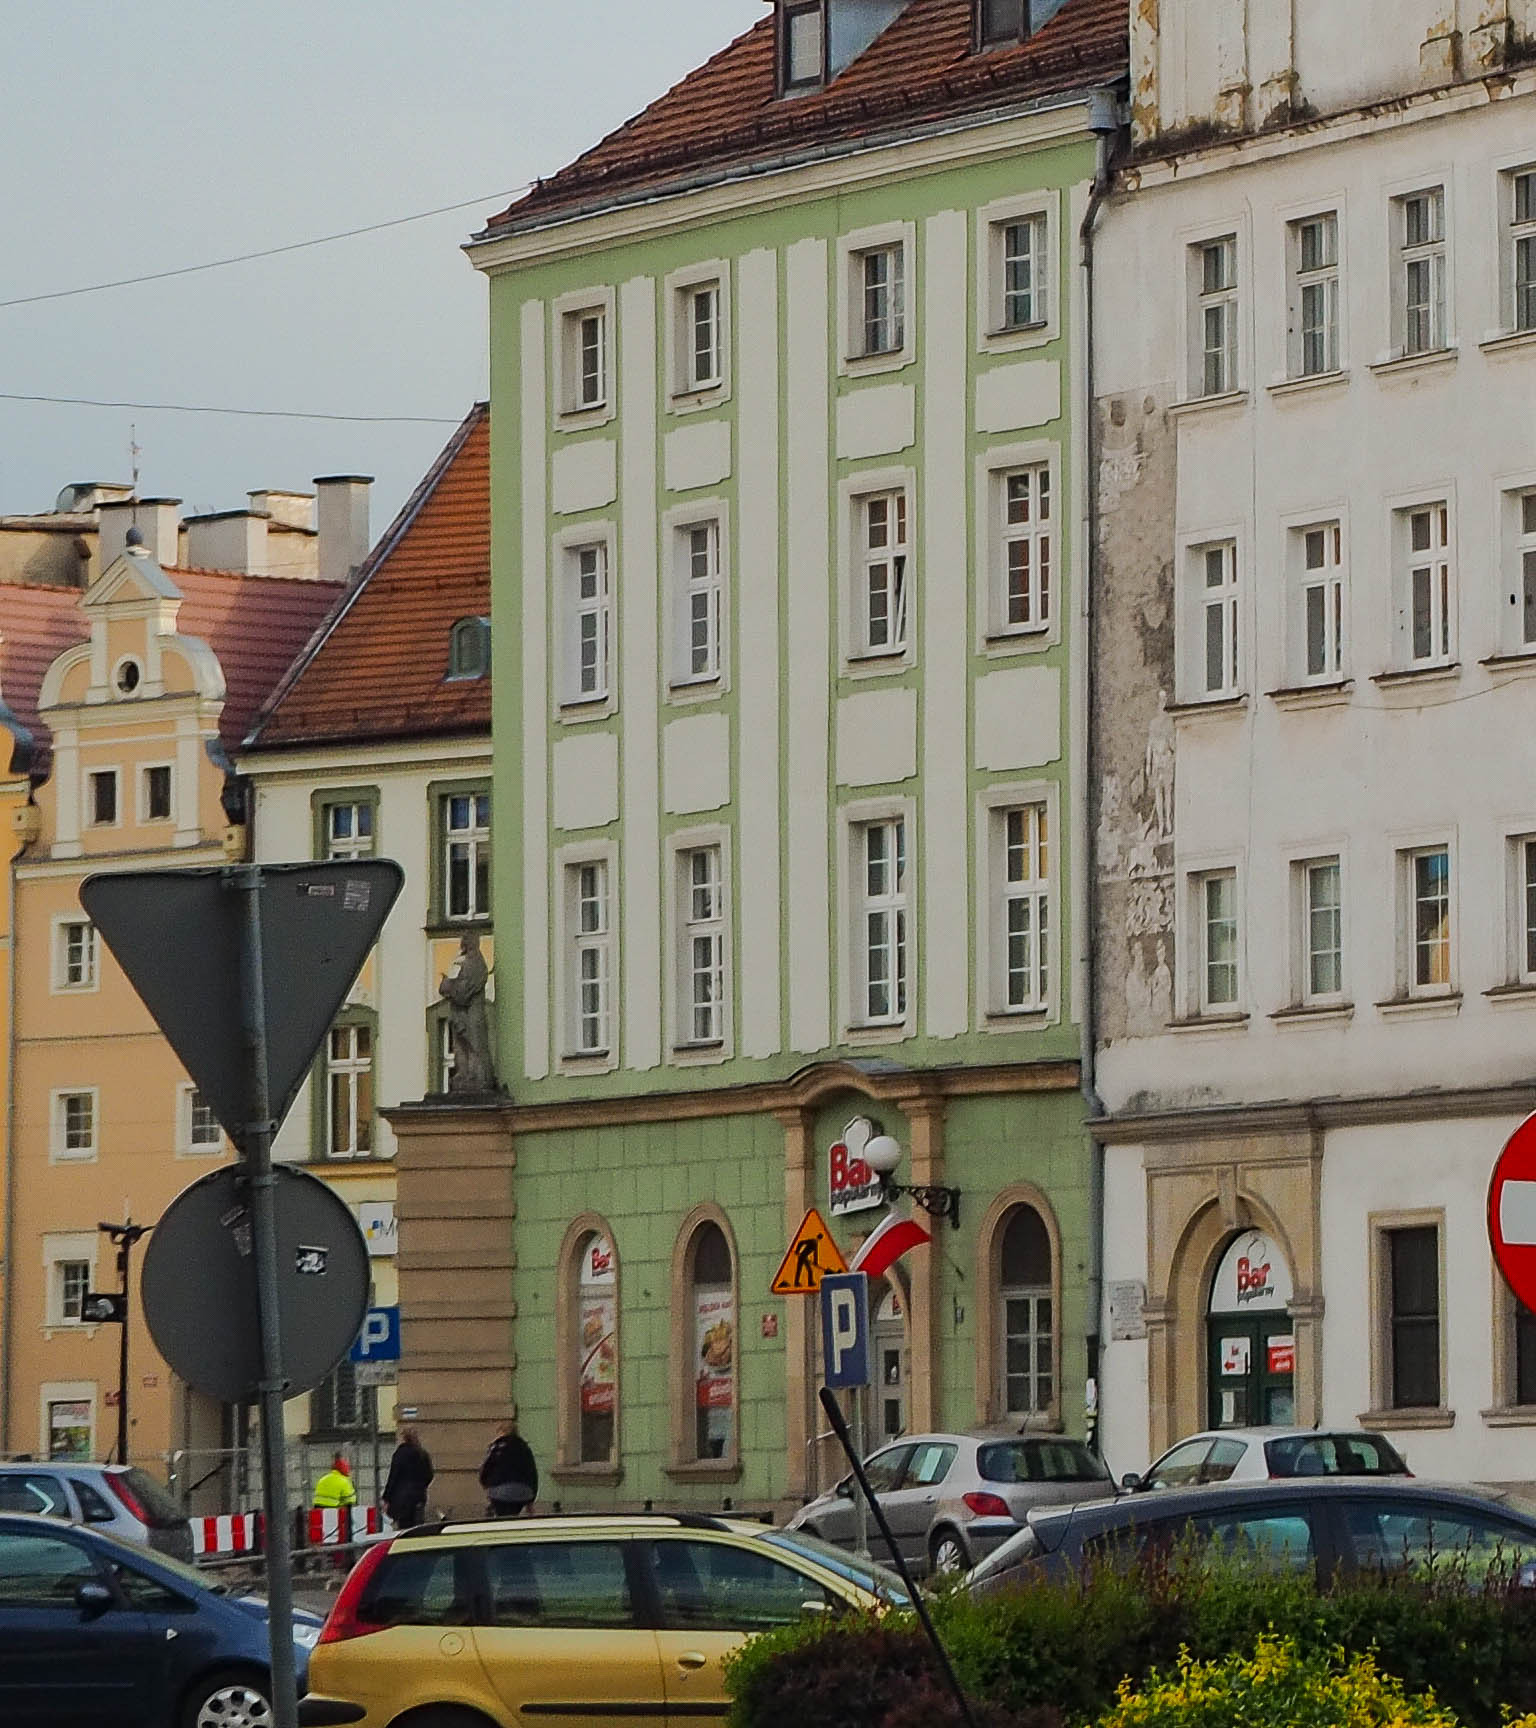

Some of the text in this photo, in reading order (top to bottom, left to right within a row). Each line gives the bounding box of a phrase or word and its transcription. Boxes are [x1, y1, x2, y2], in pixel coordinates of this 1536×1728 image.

[831, 1143, 872, 1189] Ba
[1237, 1257, 1271, 1290] Bar
[361, 1313, 390, 1355] P
[831, 1289, 857, 1374] P
